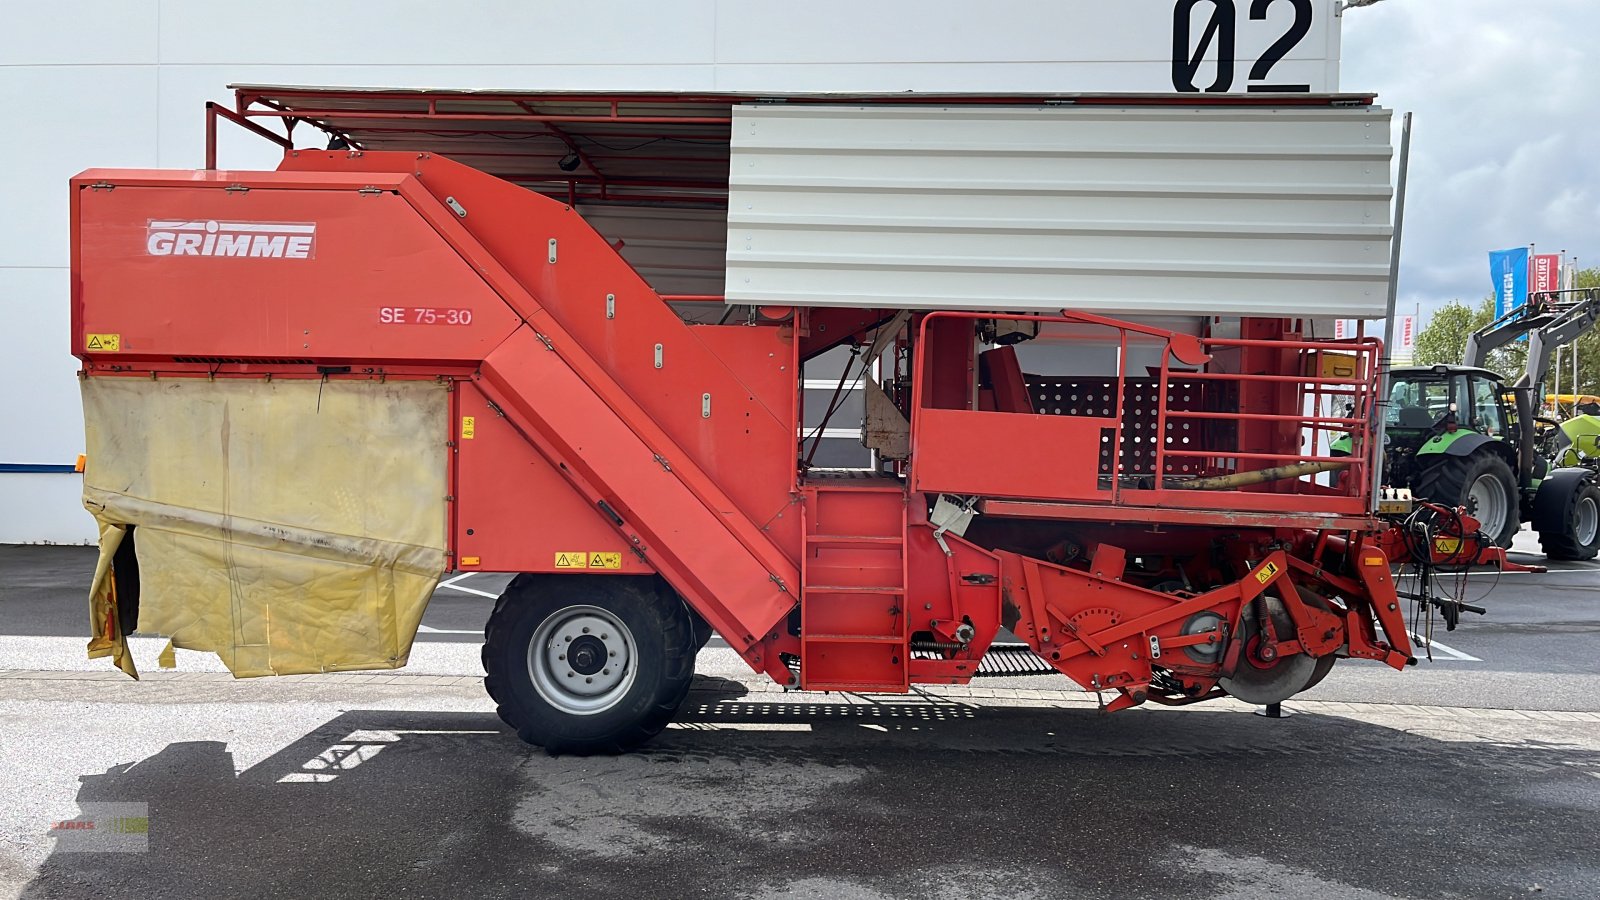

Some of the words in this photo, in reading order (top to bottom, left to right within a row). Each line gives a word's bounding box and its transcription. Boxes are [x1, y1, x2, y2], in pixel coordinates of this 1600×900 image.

[1172, 0, 1313, 93] 02
[380, 307, 405, 323] SE
[414, 308, 472, 325] 75-30
